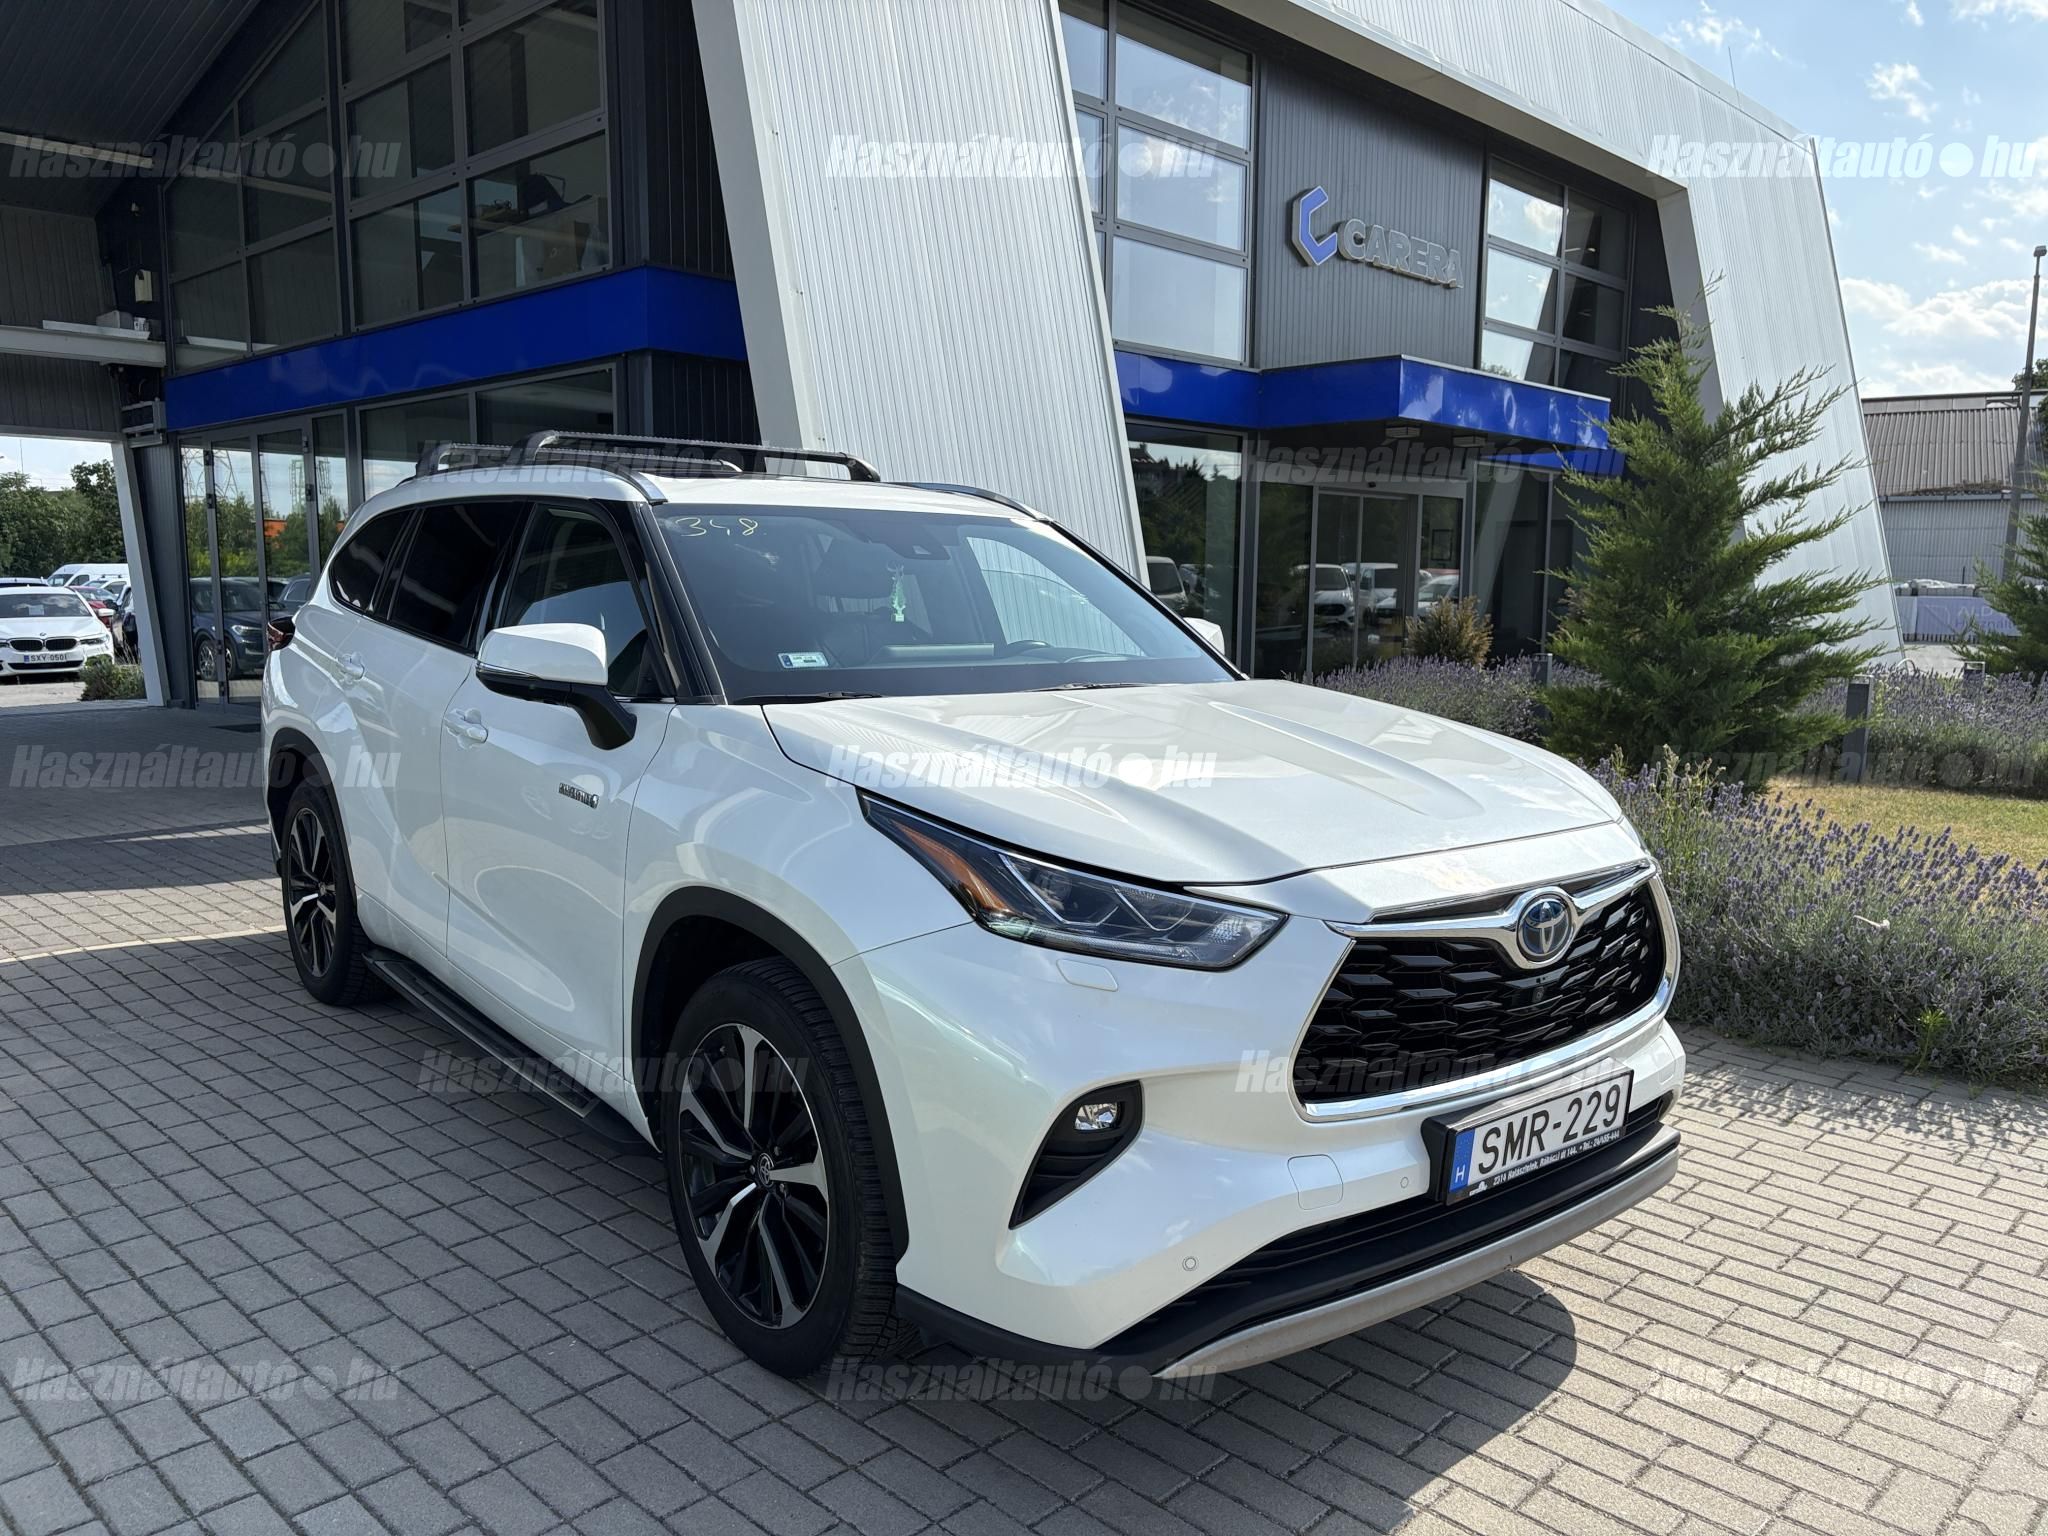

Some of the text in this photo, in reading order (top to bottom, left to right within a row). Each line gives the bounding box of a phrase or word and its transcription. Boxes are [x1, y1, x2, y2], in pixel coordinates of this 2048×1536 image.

[1341, 218, 1464, 288] CARERA
[1478, 1083, 1621, 1175] SMR-229
[1455, 1164, 1466, 1183] H
